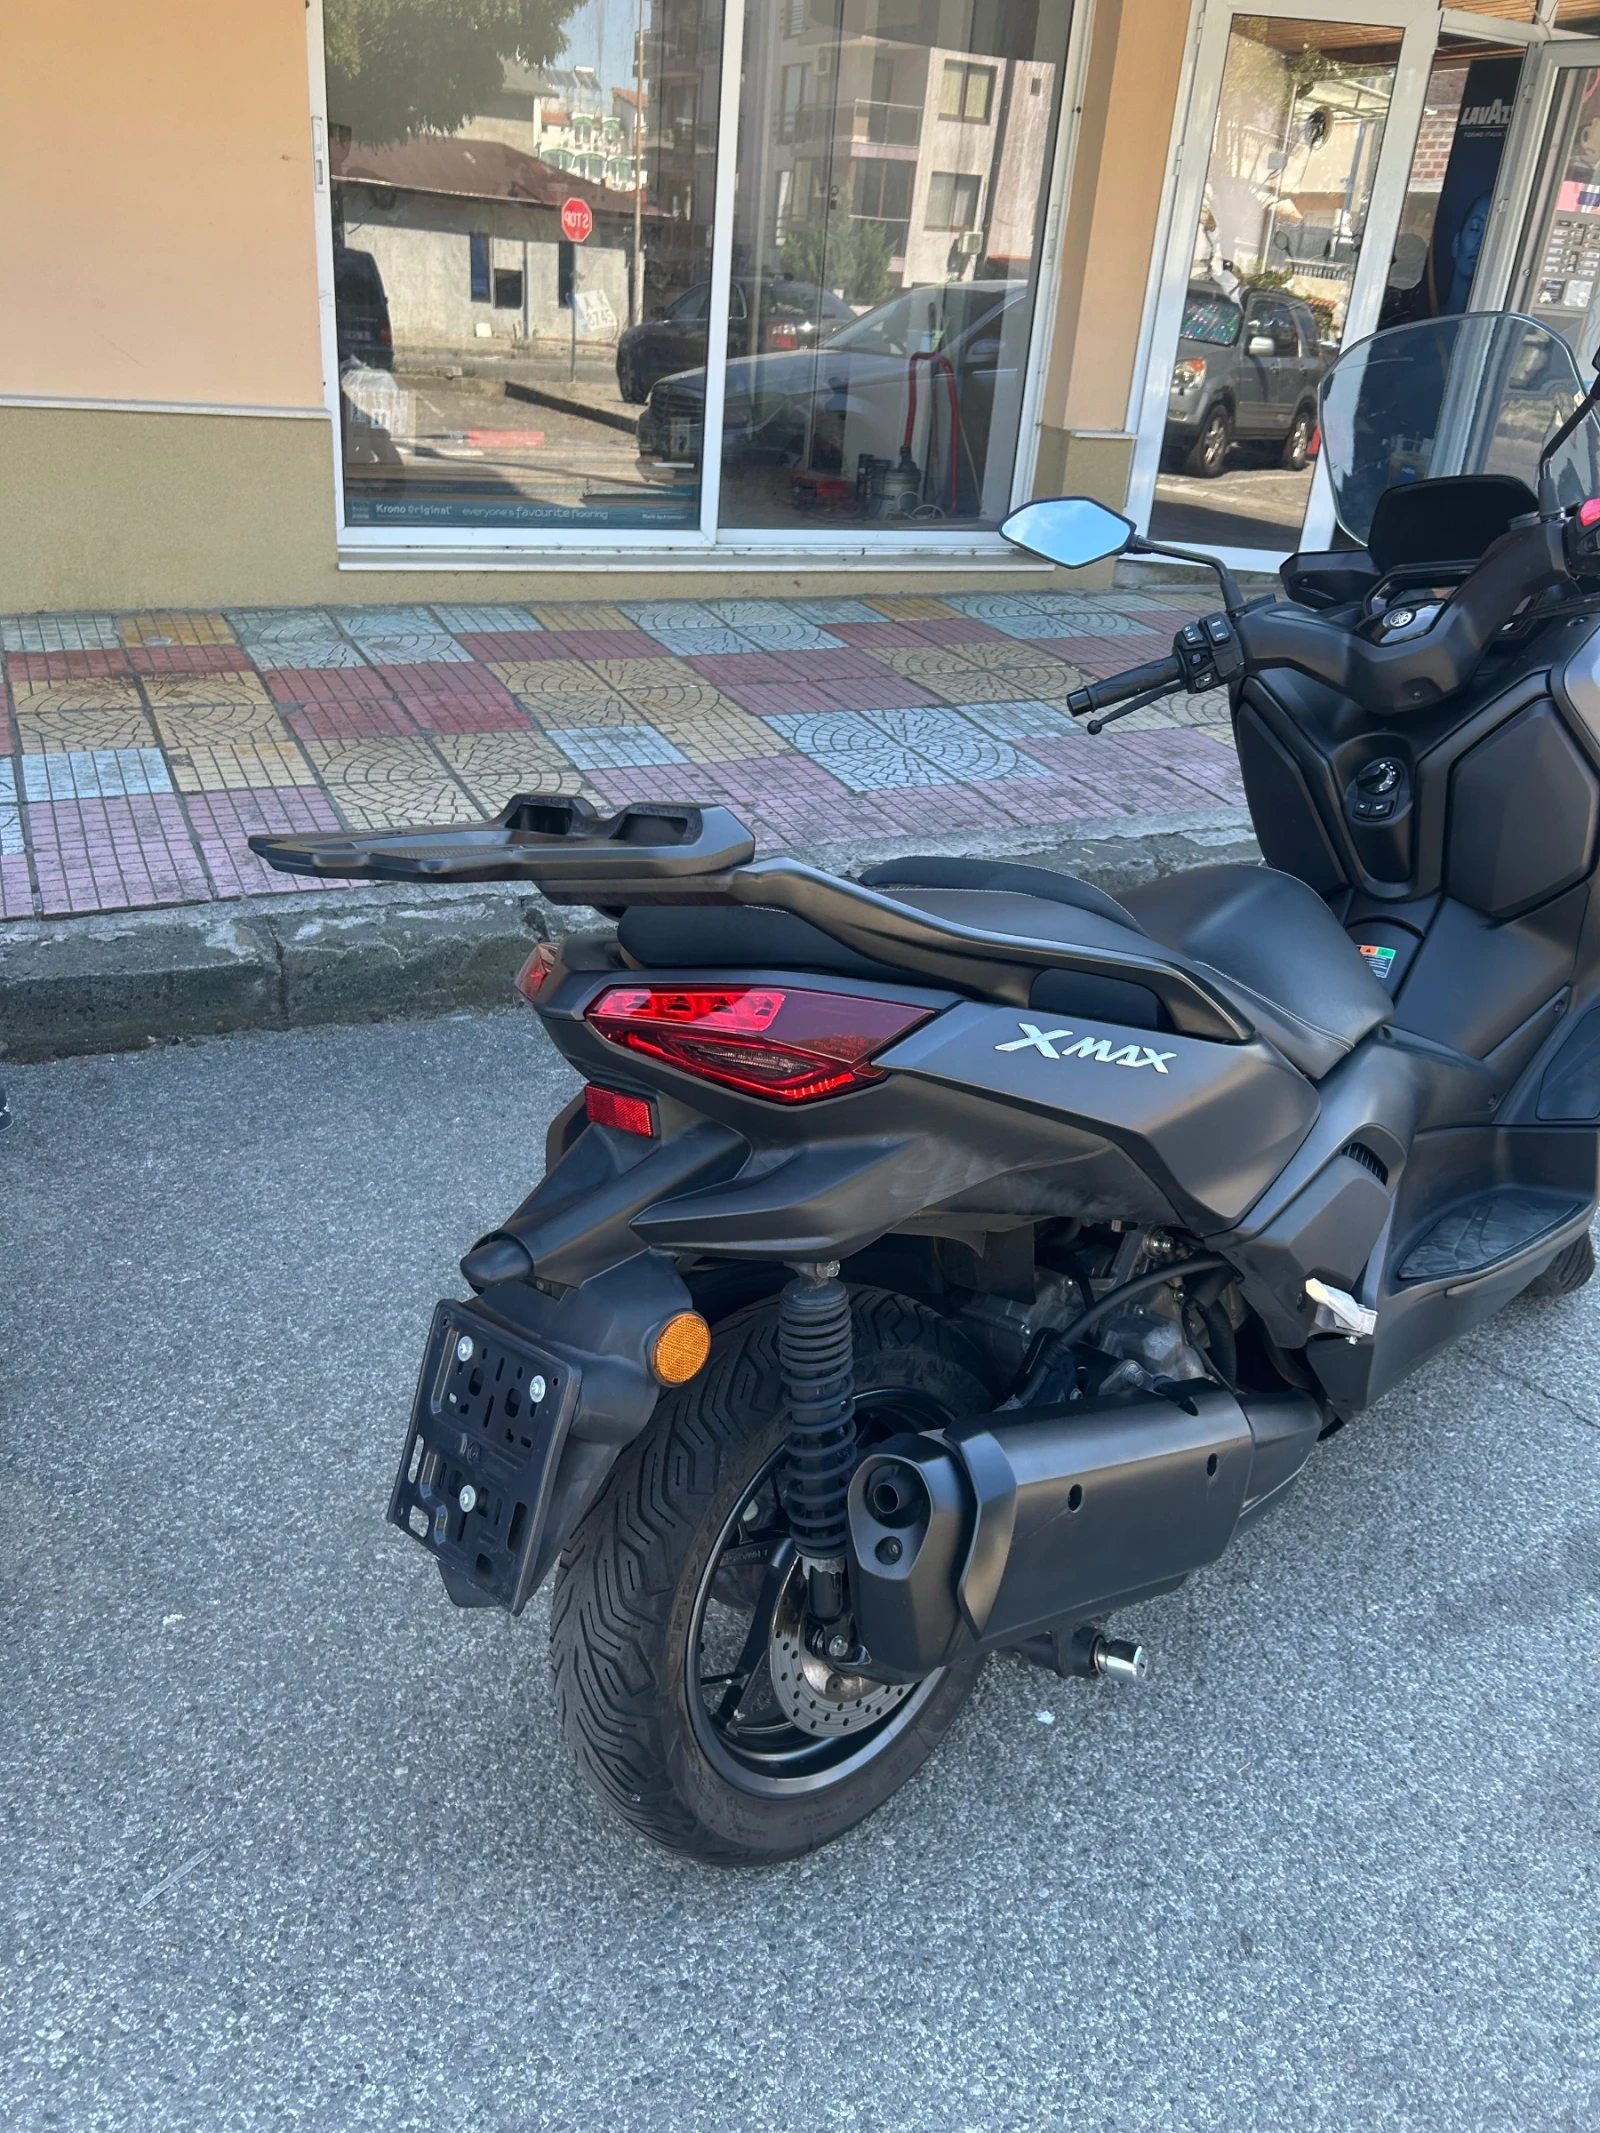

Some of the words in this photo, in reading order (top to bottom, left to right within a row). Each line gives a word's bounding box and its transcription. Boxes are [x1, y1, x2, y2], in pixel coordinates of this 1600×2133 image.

[1460, 99, 1512, 125] LAVAZ
[376, 503, 406, 514] Krono
[462, 507, 515, 518] everyone's
[516, 506, 570, 519] favourite
[571, 509, 609, 520] flooring
